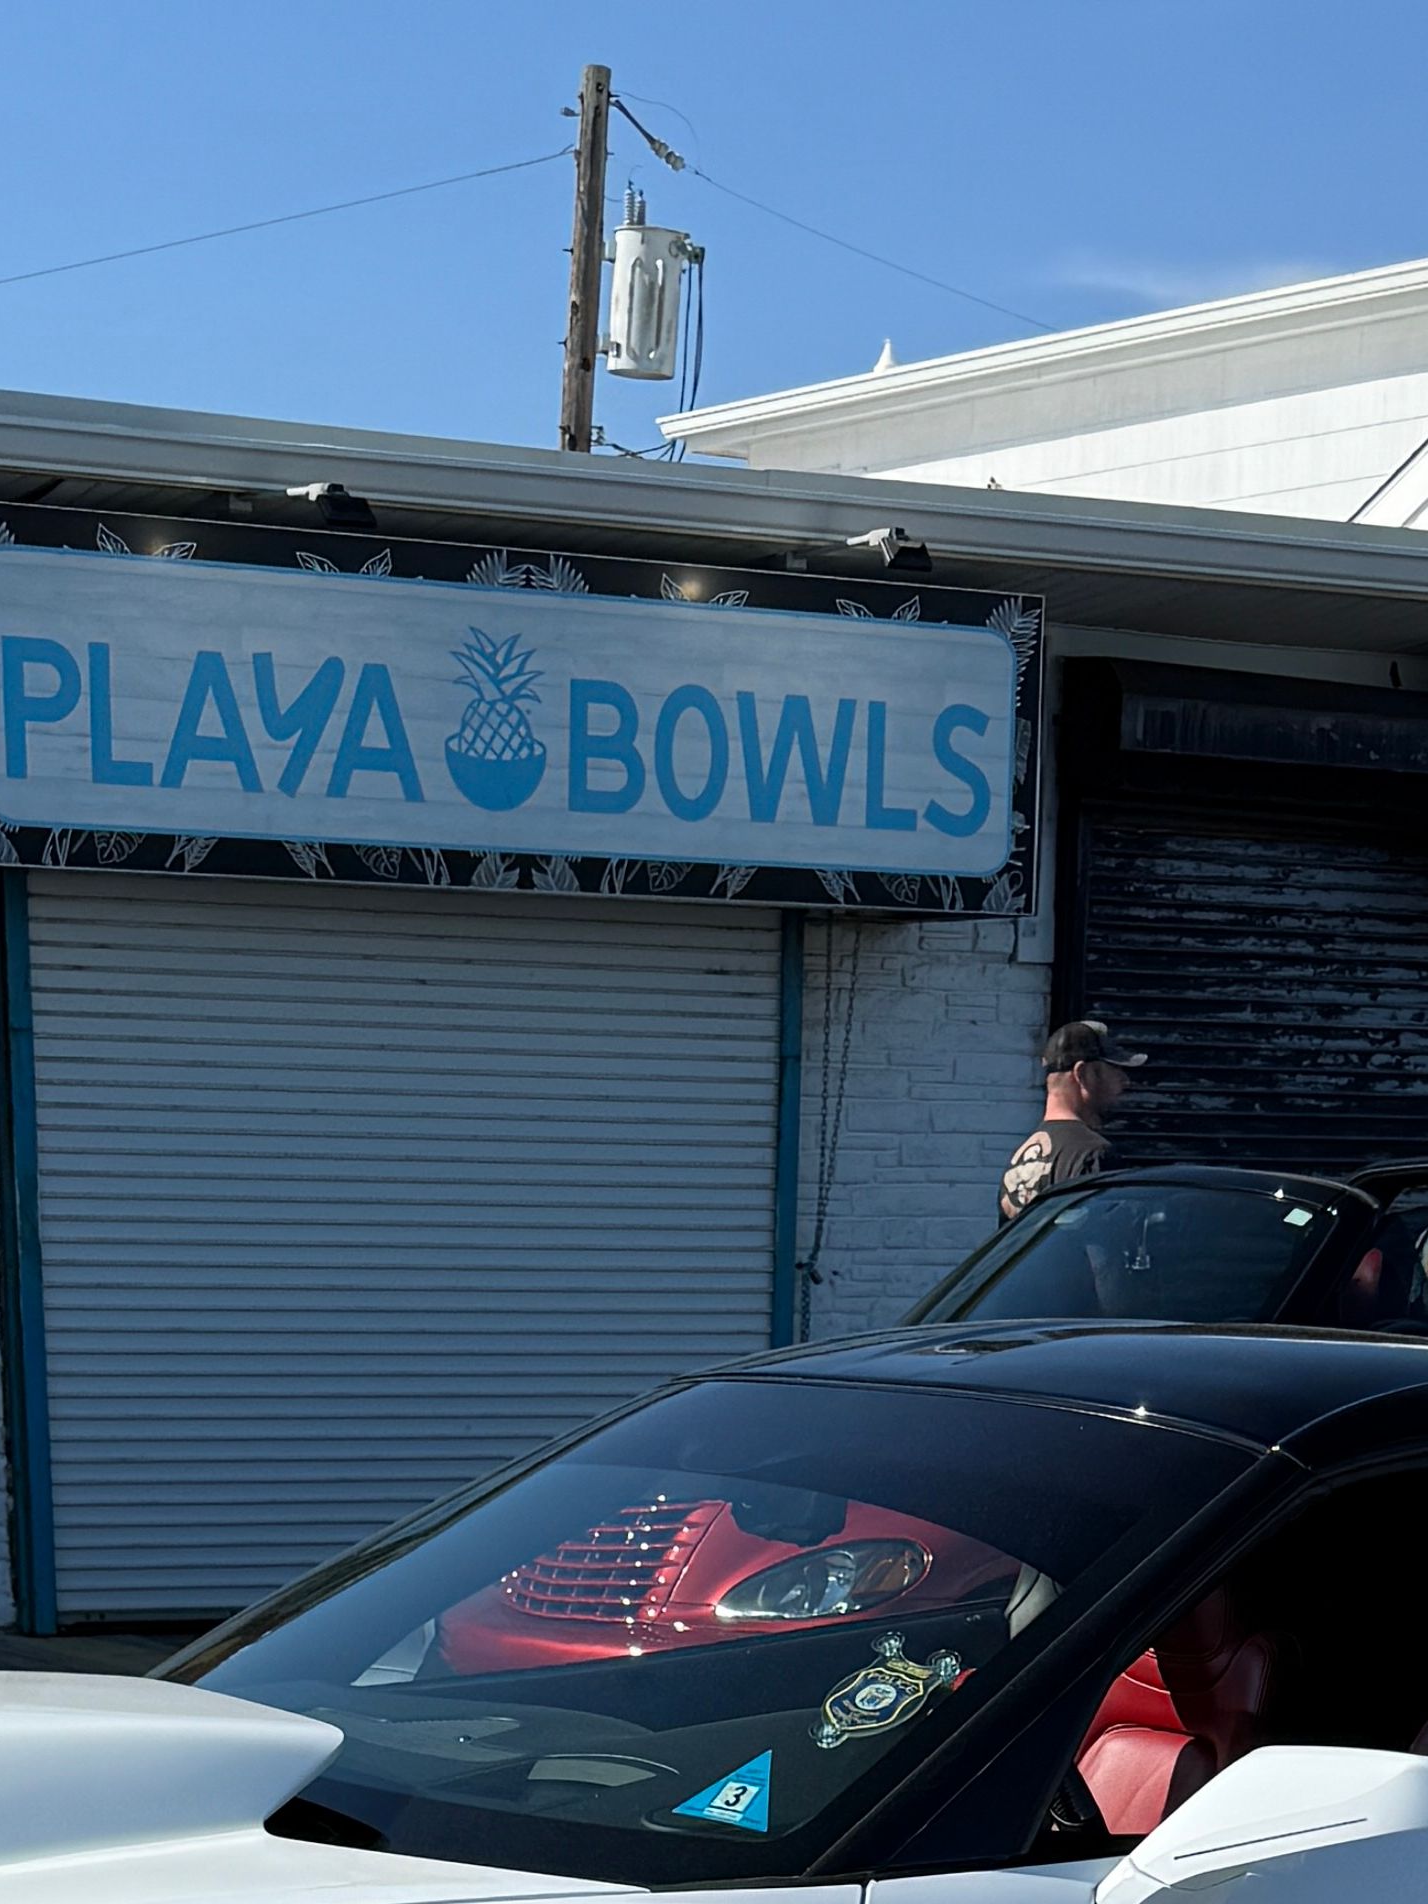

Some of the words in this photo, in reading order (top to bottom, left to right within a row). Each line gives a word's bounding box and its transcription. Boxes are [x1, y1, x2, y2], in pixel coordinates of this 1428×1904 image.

[0, 635, 426, 802] PLAYA
[568, 677, 991, 838] BOWLS
[866, 1671, 919, 1695] POLICE
[724, 1785, 748, 1807] 3
